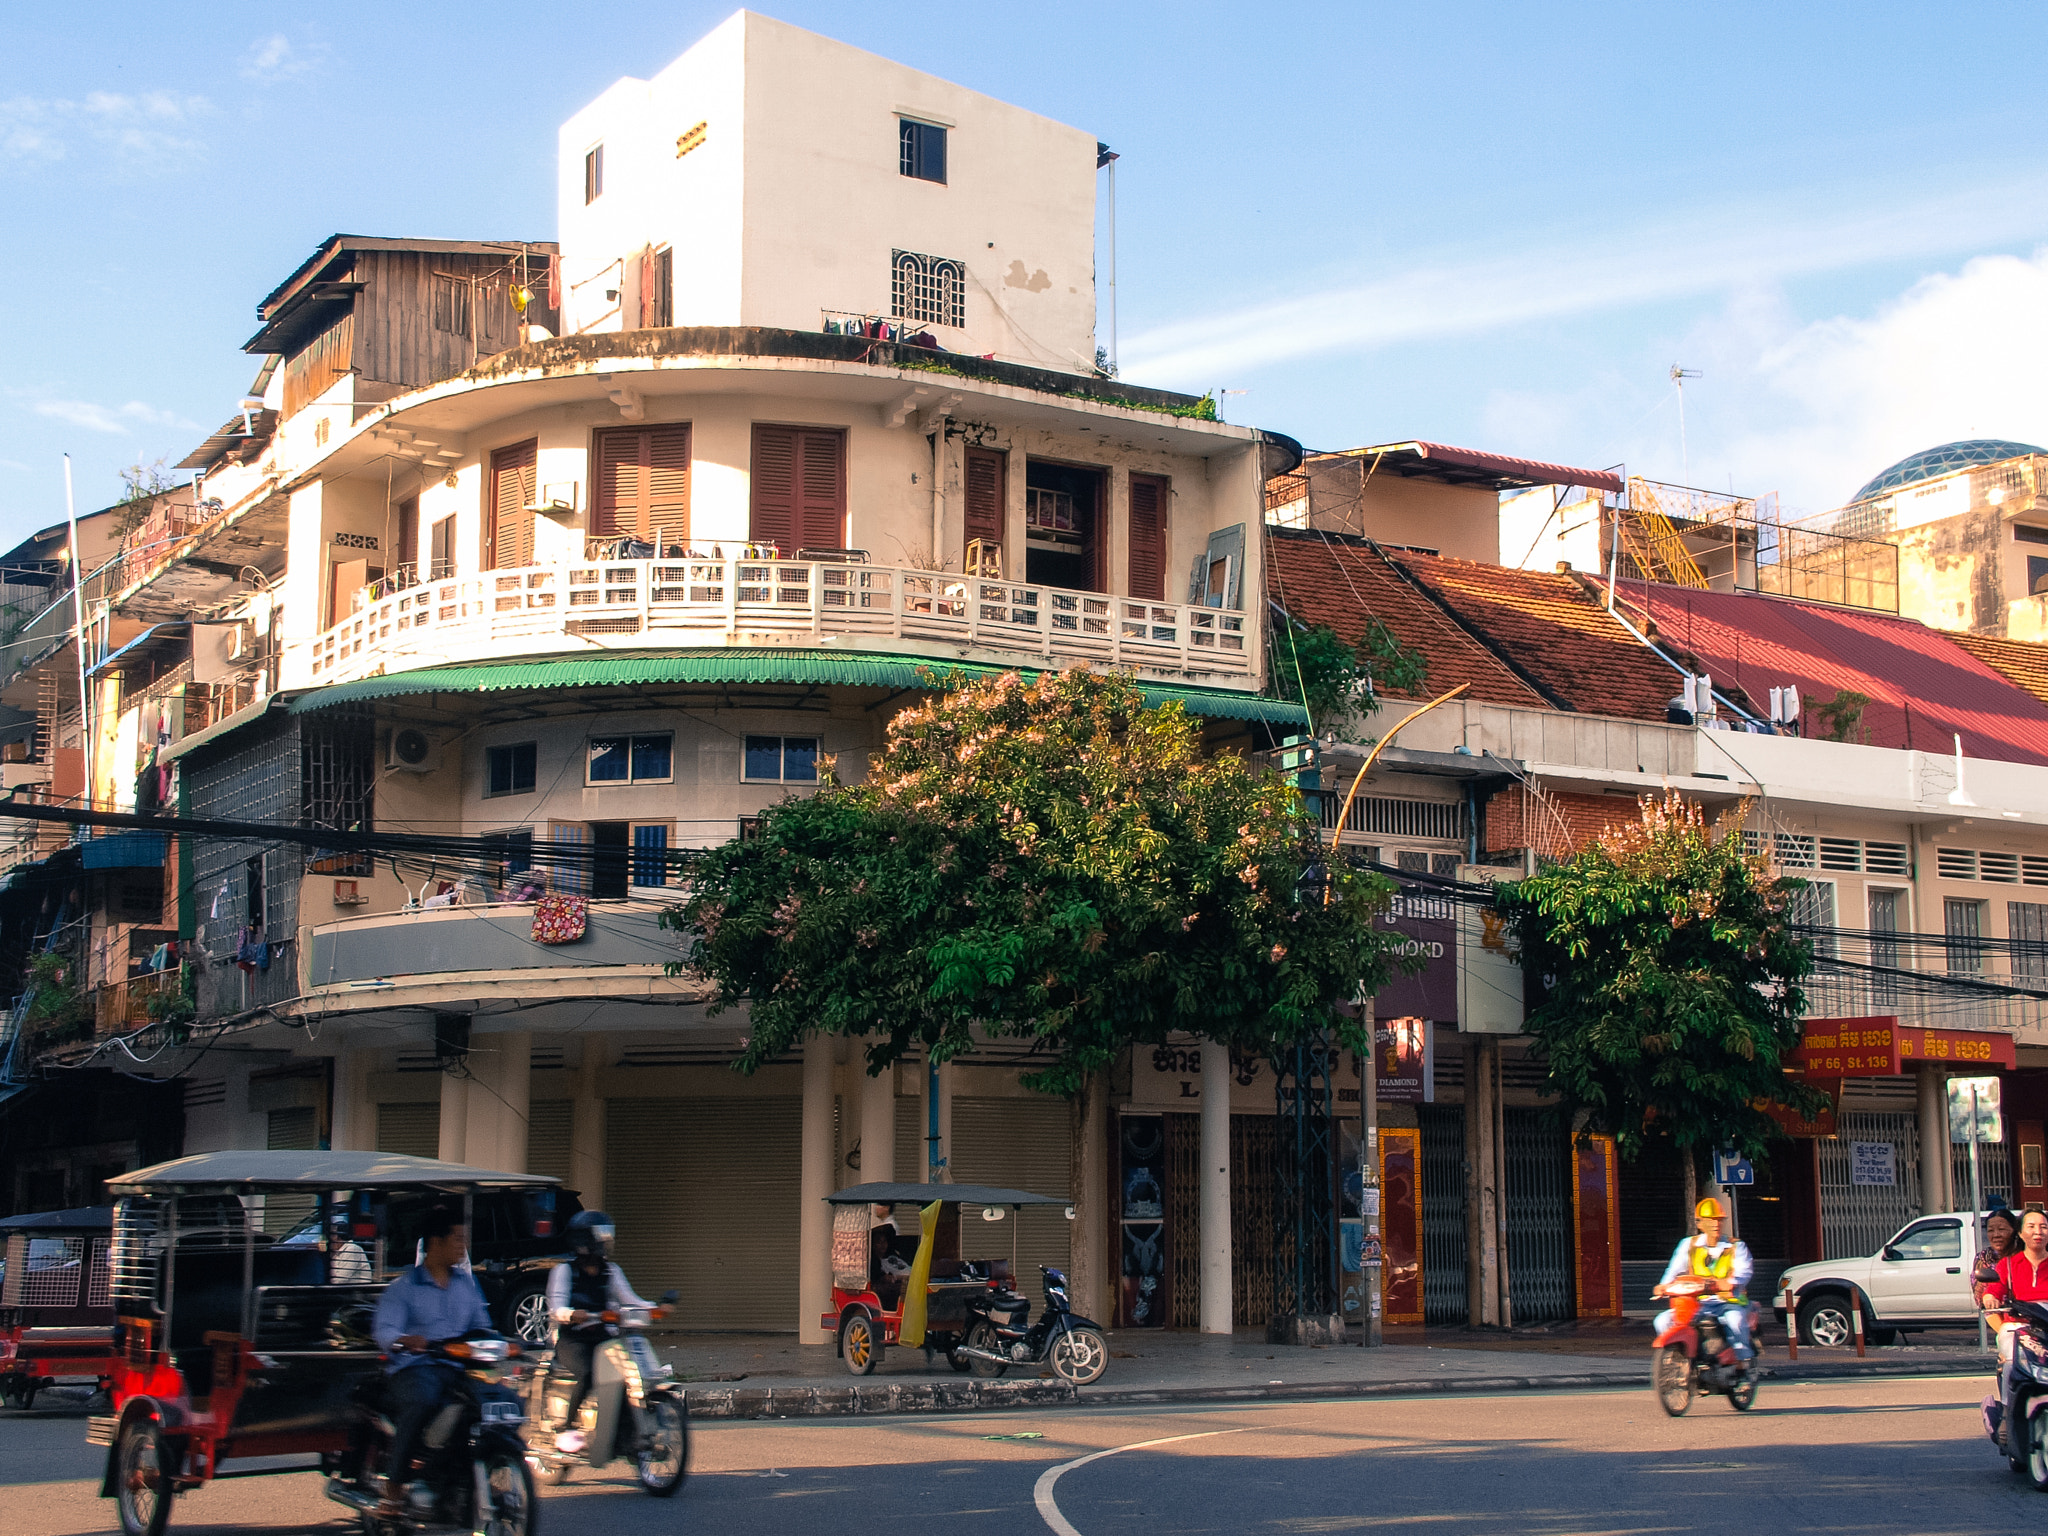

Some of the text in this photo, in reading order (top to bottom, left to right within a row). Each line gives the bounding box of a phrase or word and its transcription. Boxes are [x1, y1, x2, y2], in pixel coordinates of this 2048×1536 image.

[1381, 939, 1445, 958] AMOND
[1867, 1056, 1889, 1068] 136
[1379, 1078, 1419, 1087] DIAMOND
